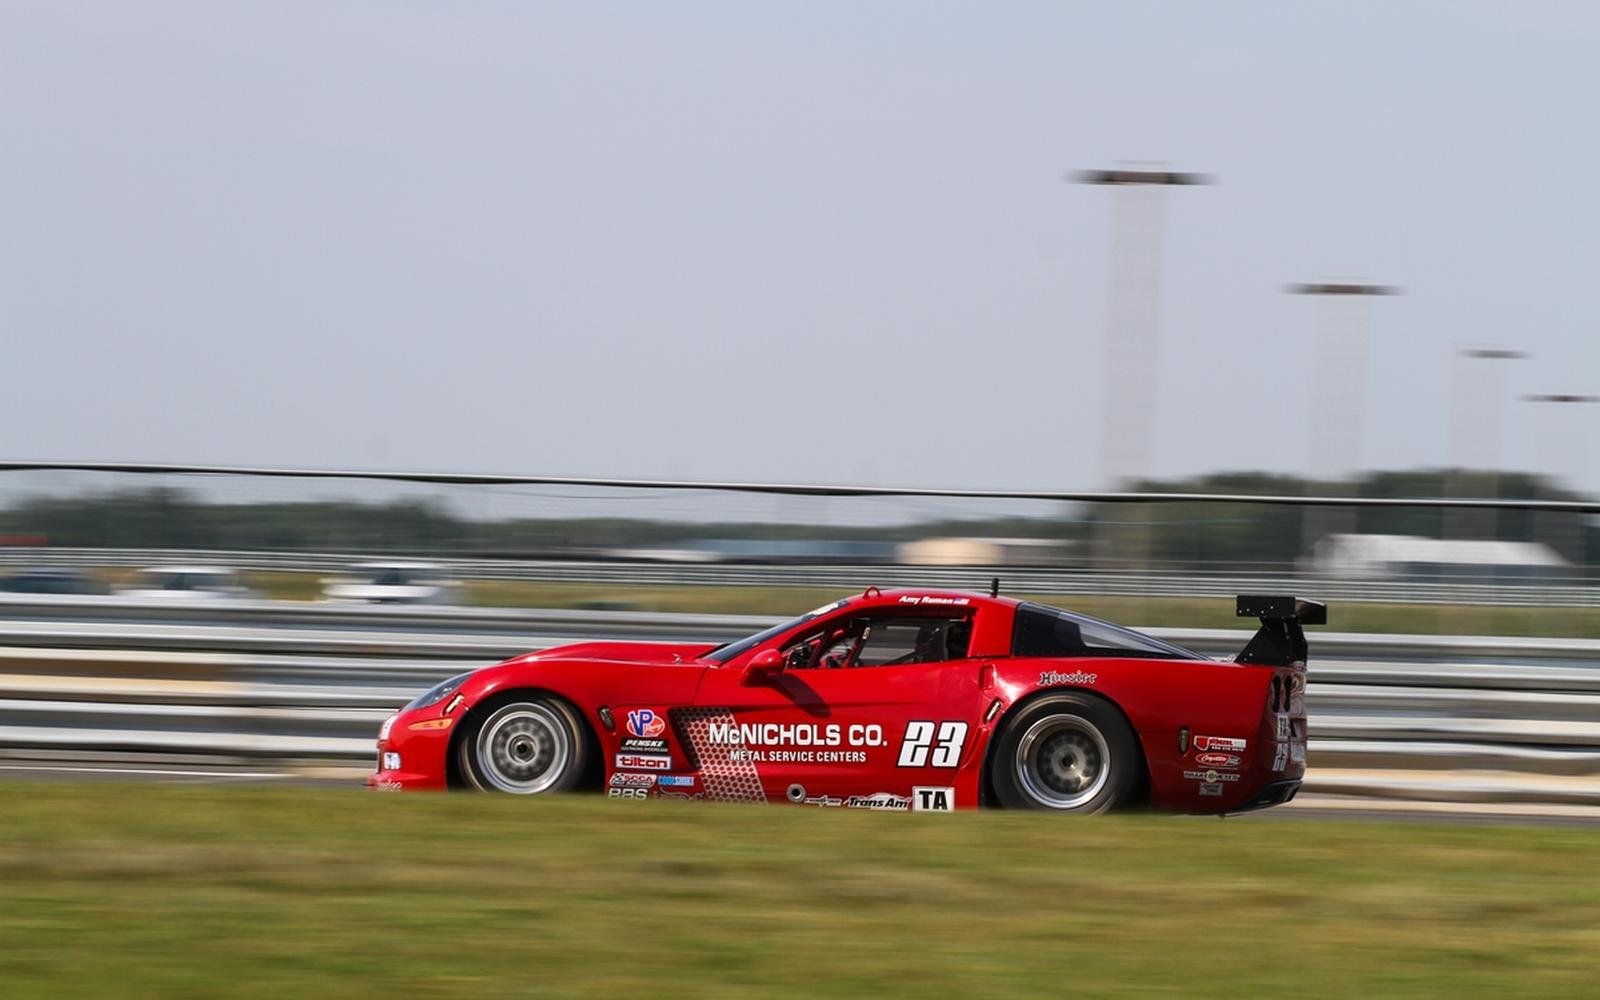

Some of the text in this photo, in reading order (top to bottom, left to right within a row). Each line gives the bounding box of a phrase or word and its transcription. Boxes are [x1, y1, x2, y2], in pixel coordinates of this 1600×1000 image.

[899, 595, 954, 605] Amy Ruman
[1037, 670, 1098, 687] Hoosier
[627, 709, 655, 737] VP
[709, 723, 888, 747] McNICHOLS CO.
[625, 739, 665, 748] PENSKE
[897, 719, 968, 769] 23
[619, 756, 668, 768] tilton
[730, 750, 867, 763] METAL SERVICE CENTERS
[623, 774, 653, 782] SCCA
[850, 797, 884, 807] Trans
[884, 798, 908, 809] Am
[918, 790, 949, 810] TA
